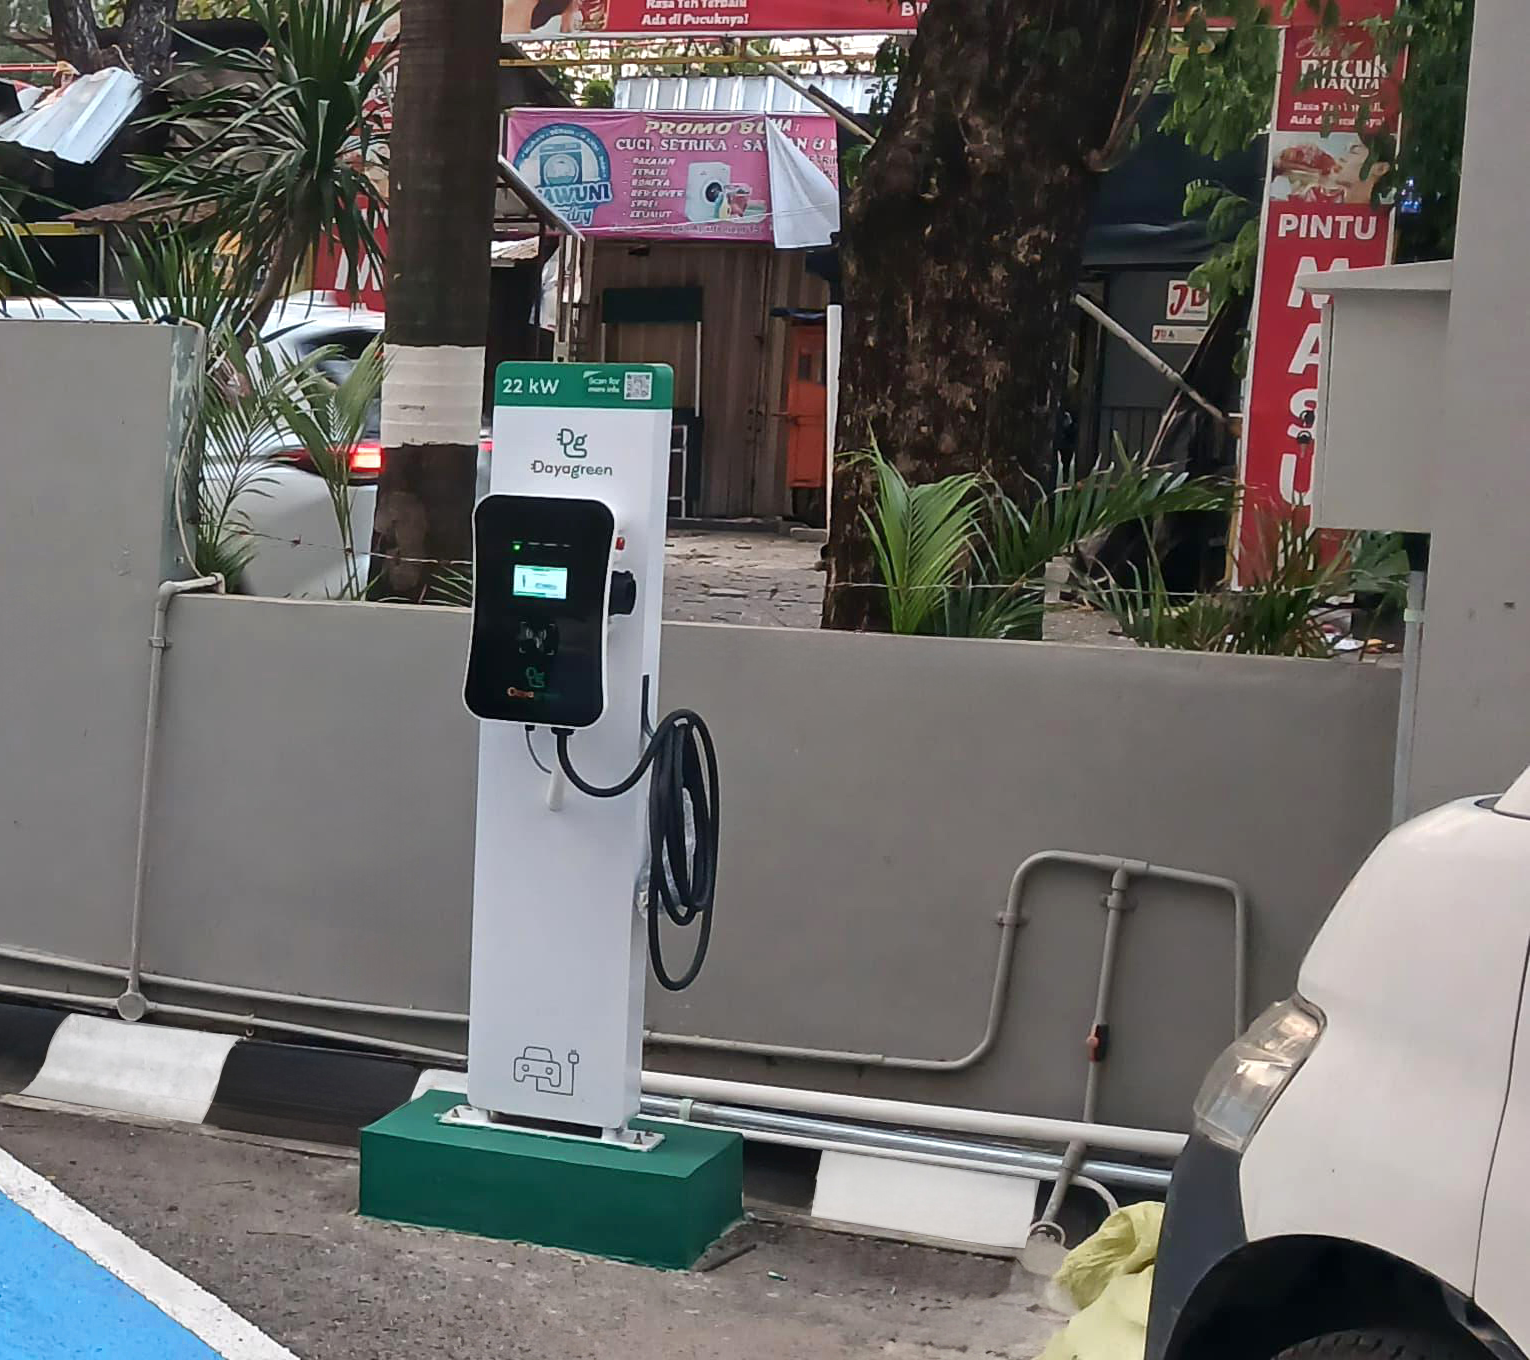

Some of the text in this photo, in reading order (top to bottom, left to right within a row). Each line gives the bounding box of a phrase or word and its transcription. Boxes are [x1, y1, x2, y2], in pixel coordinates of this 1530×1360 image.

[642, 14, 666, 25] Ada
[668, 14, 681, 25] di
[644, 120, 734, 135] PROMO
[615, 139, 655, 152] CUCI,
[661, 139, 727, 152] SETRIKA
[1278, 214, 1377, 240] PINTU
[502, 378, 560, 394] 22 kW
[588, 377, 620, 386] Scan for
[530, 460, 613, 479] Dayagreen
